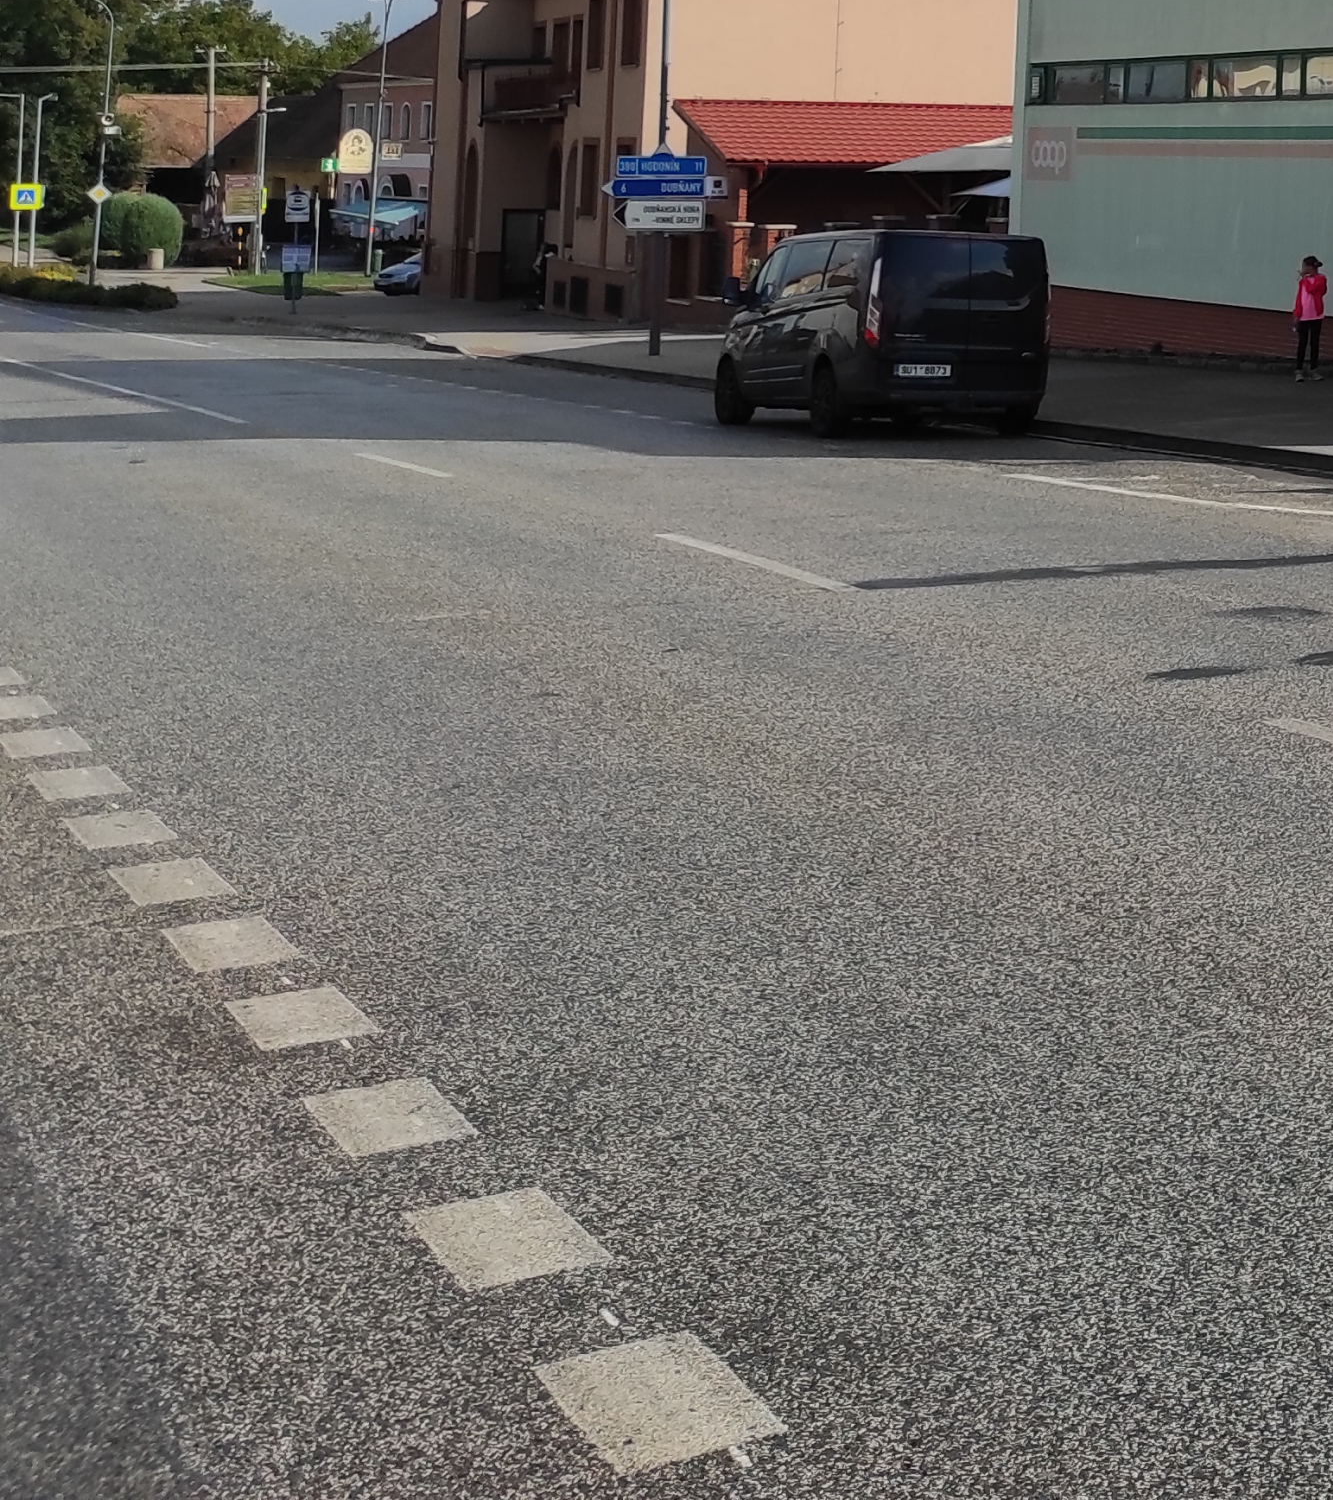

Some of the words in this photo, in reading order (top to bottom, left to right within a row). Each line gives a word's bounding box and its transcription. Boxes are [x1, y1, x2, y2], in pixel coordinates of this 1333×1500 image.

[1032, 140, 1066, 175] coop
[619, 161, 636, 172] 380
[641, 160, 680, 172] HODONÍN
[620, 183, 627, 193] 6
[661, 181, 701, 193] DUBŇANY
